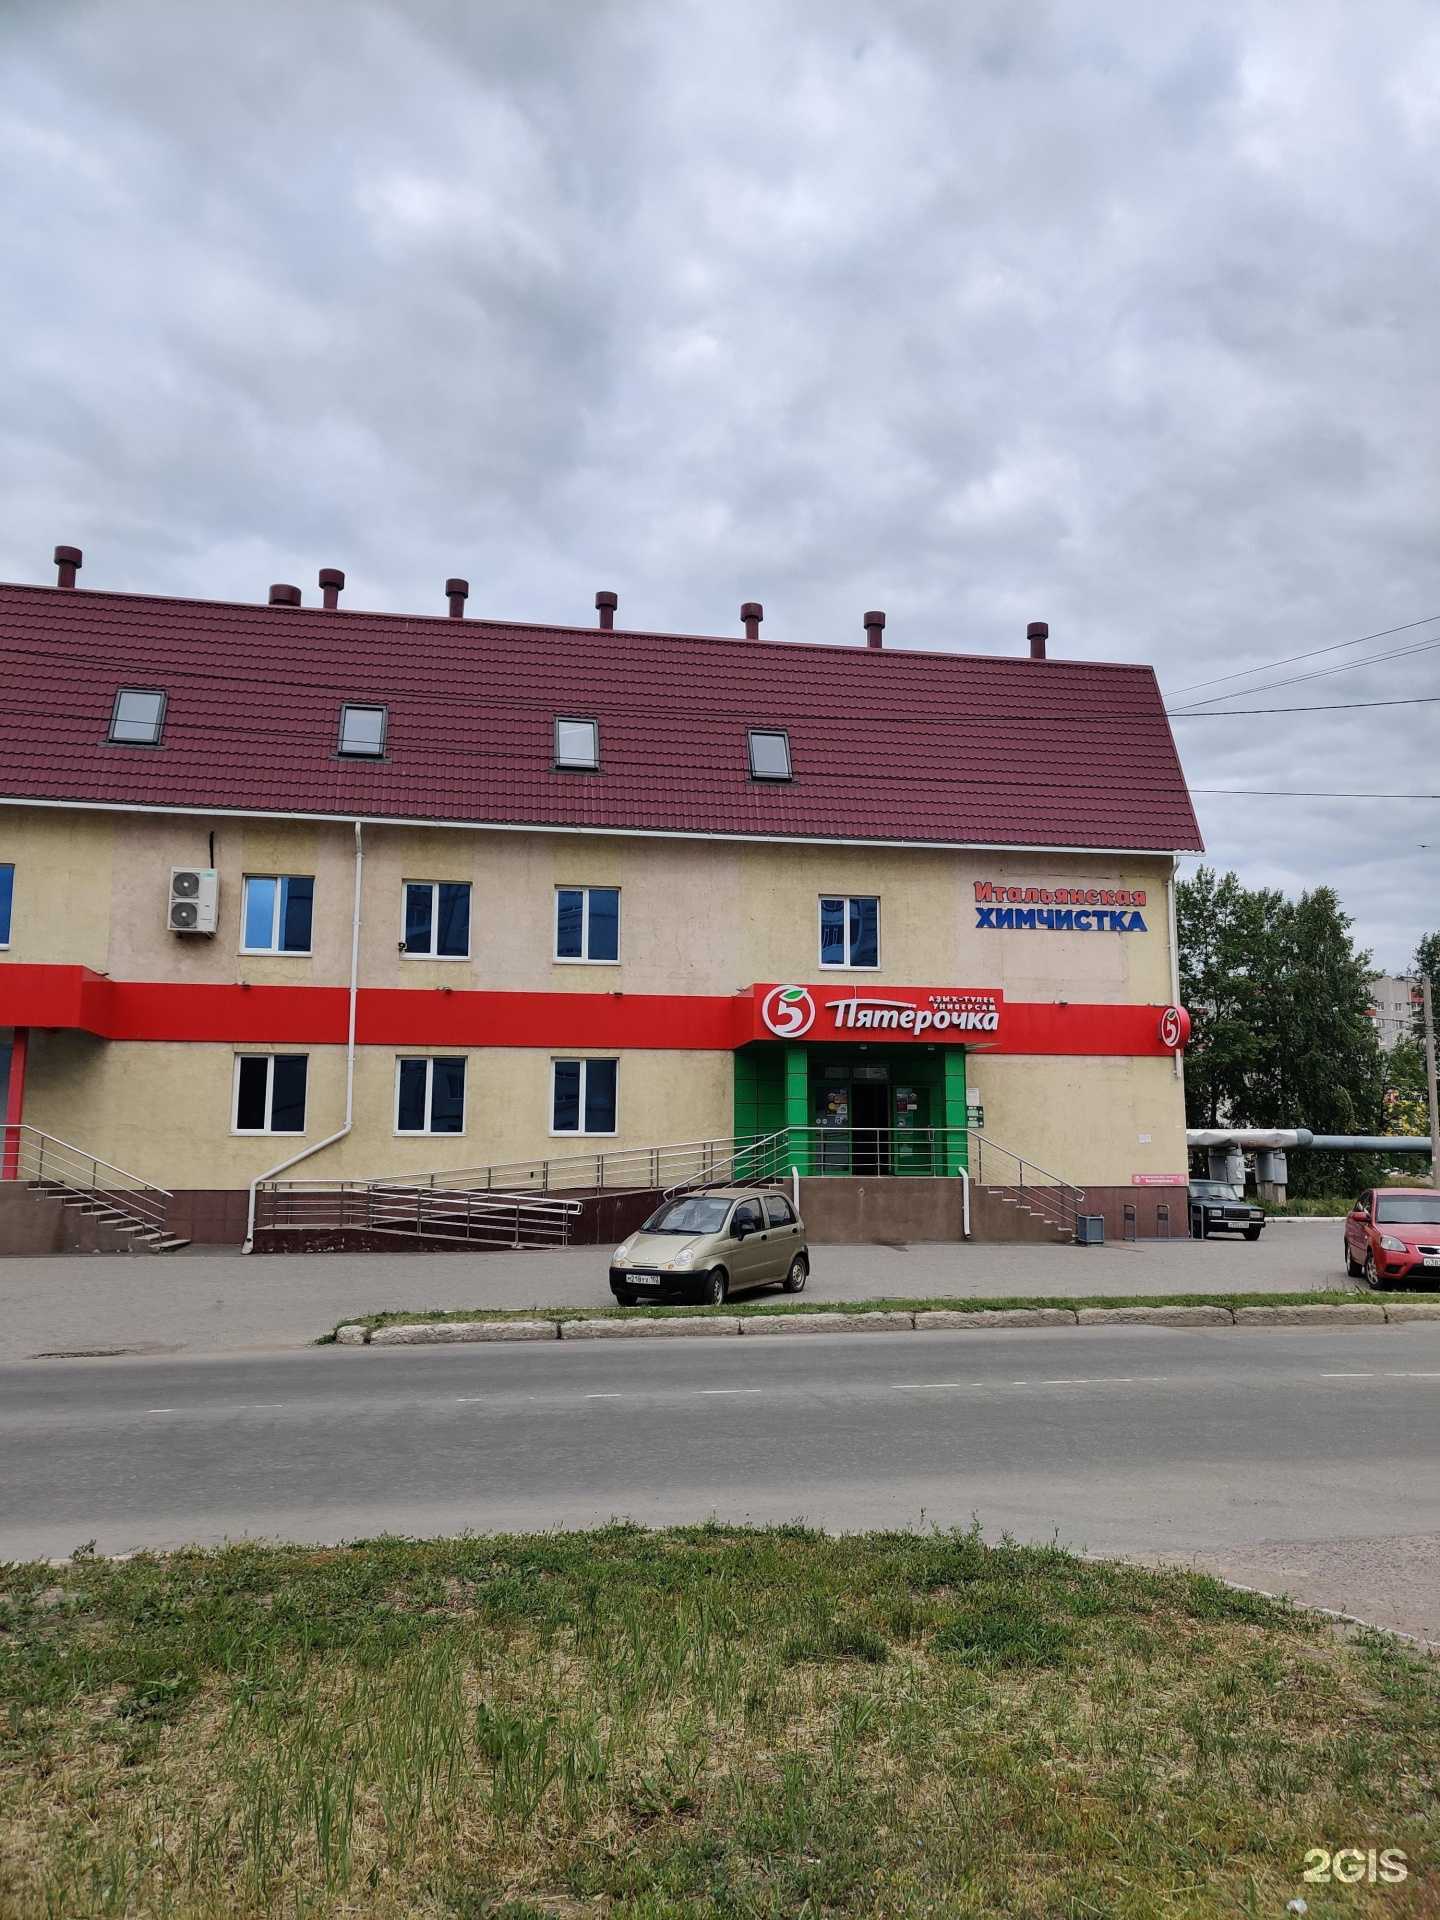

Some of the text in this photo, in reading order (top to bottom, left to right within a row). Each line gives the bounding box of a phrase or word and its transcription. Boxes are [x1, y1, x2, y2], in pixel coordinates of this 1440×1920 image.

[974, 881, 1147, 906] Итальянская
[975, 907, 1148, 932] ХИМЧИСТКА
[776, 998, 803, 1033] 5
[825, 999, 1000, 1035] Пятерочка
[933, 1003, 996, 1011] УНИВЕРСАМ
[1166, 1018, 1177, 1043] 5
